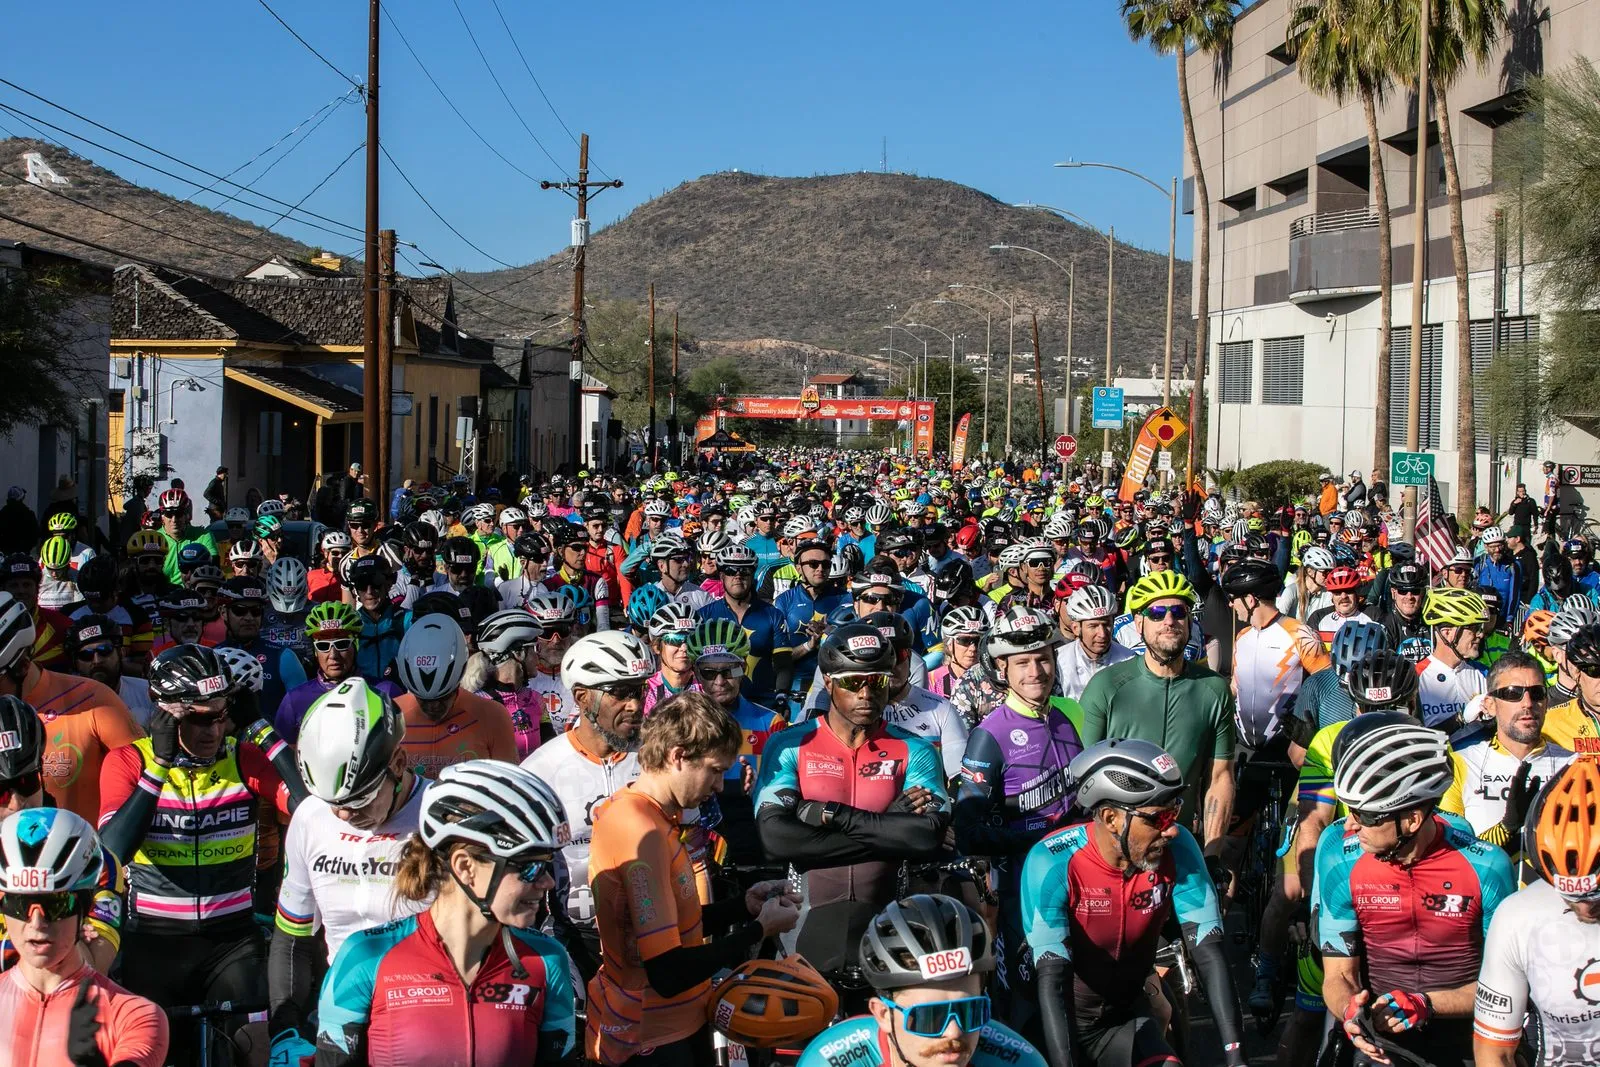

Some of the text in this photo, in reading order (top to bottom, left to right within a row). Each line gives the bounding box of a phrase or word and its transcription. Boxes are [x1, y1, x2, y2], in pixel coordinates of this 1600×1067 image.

[953, 436, 965, 464] SILVER
[1056, 441, 1076, 451] STOP
[1128, 443, 1153, 485] GOLD
[1394, 475, 1409, 484] BIKE
[322, 619, 340, 630] 5350
[1014, 615, 1036, 629] 6394
[81, 626, 99, 638] 5382
[851, 635, 873, 647] 5288
[416, 655, 437, 667] 6627
[203, 674, 224, 694] 7467
[1422, 702, 1466, 717] Rotary
[345, 751, 359, 791] MET
[820, 762, 844, 771] GROUP
[1018, 772, 1063, 812] COURTNEY'S
[1044, 829, 1080, 848] Bicycle
[1051, 836, 1078, 856] Ranch
[1451, 834, 1485, 856] Ranch
[1453, 829, 1494, 851] Bicycle
[147, 848, 188, 858] GRAN
[1558, 877, 1592, 893] 5643
[1370, 896, 1400, 904] GROUP
[926, 950, 967, 975] 6962
[388, 987, 449, 999] ELL GROUP
[819, 1028, 871, 1059] Bicycle
[981, 1026, 1034, 1054] Bicycle
[828, 1044, 869, 1067] Ranch
